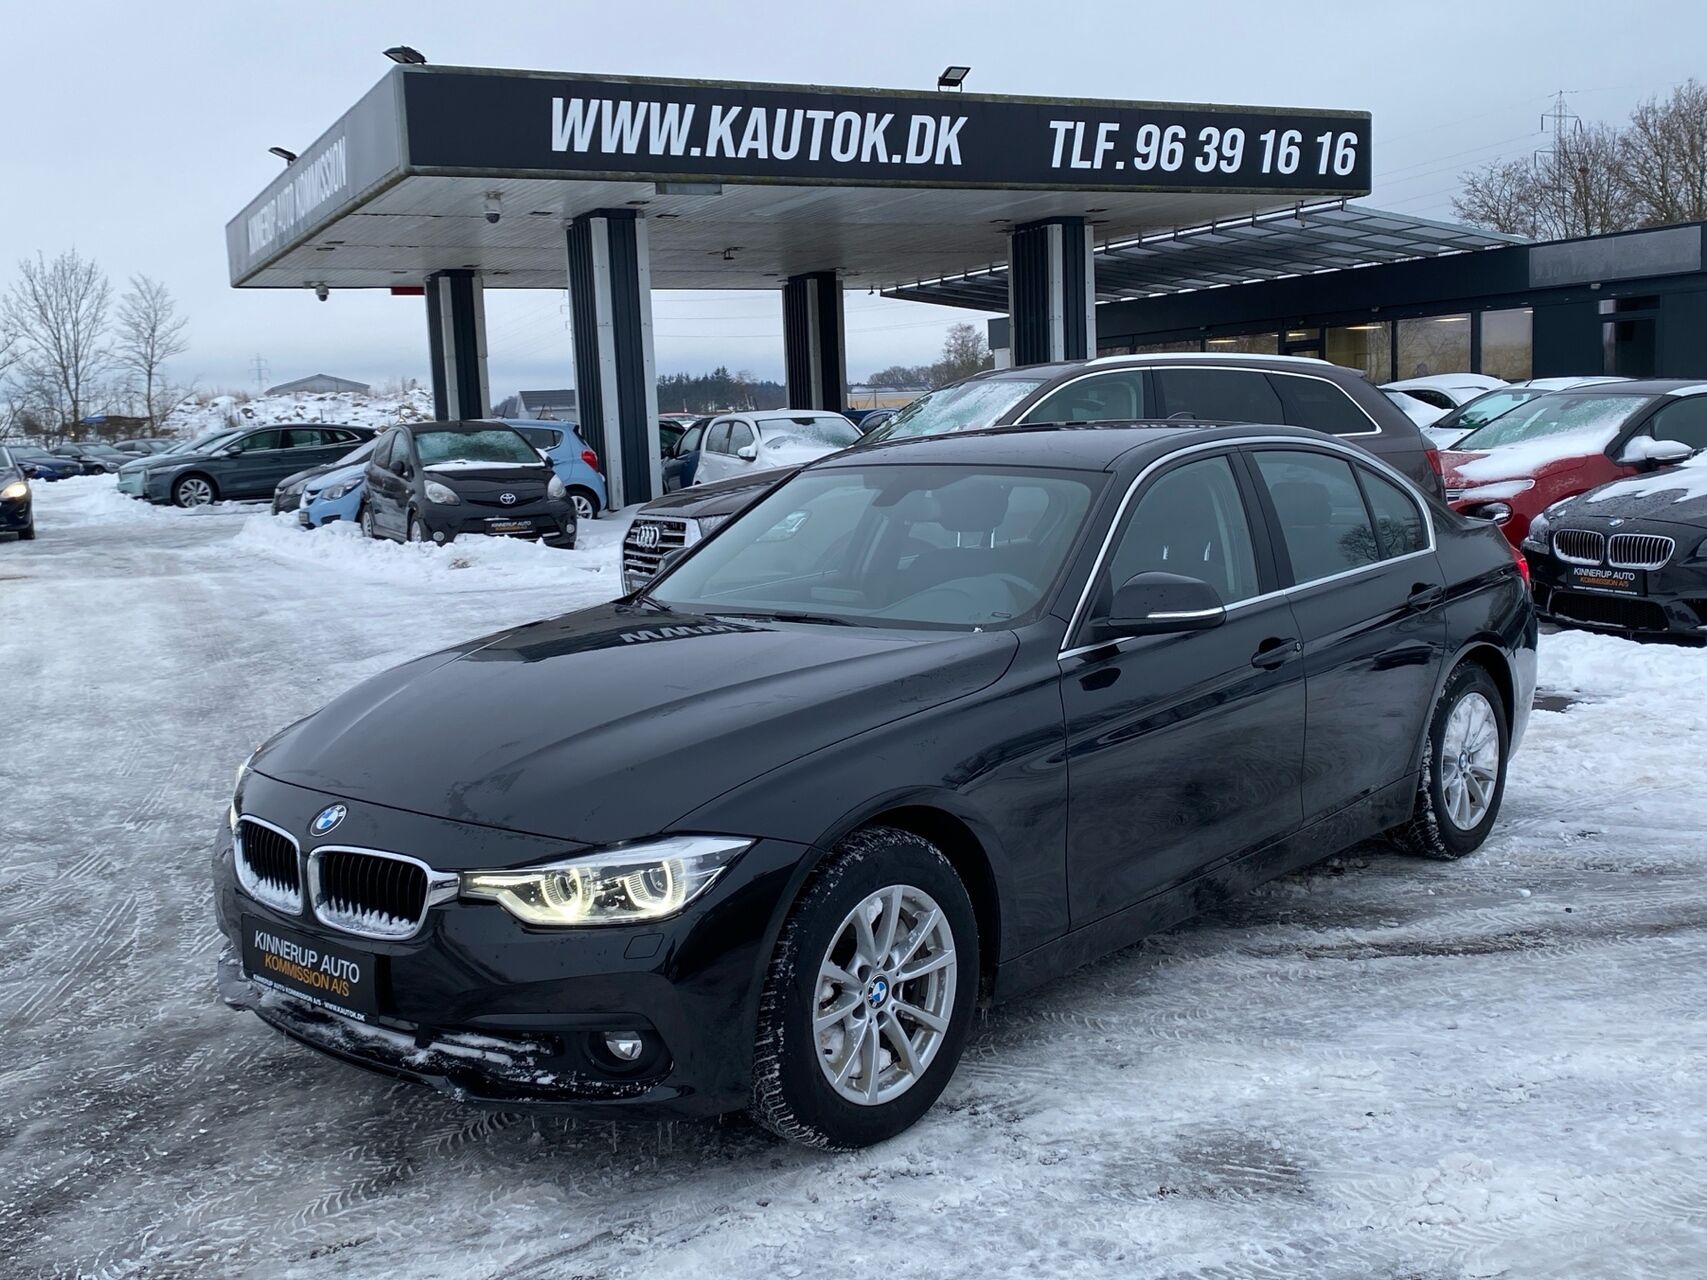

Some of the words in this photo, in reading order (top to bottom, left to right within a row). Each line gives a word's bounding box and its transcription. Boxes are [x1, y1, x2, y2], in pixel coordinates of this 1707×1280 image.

[551, 97, 968, 165] WWW.KAUTOK.DK
[1049, 120, 1125, 169] TLF.
[1133, 123, 1186, 172] 96
[1195, 126, 1246, 174] 39
[1259, 129, 1302, 175] 16
[1316, 131, 1358, 176] 16
[1573, 567, 1612, 578] KINNERUP
[1613, 571, 1635, 581] AUTO
[254, 930, 317, 968] KINNERUP
[320, 954, 360, 983] AUTO
[265, 953, 329, 990] KOMMISSION
[331, 978, 350, 997] A/S
